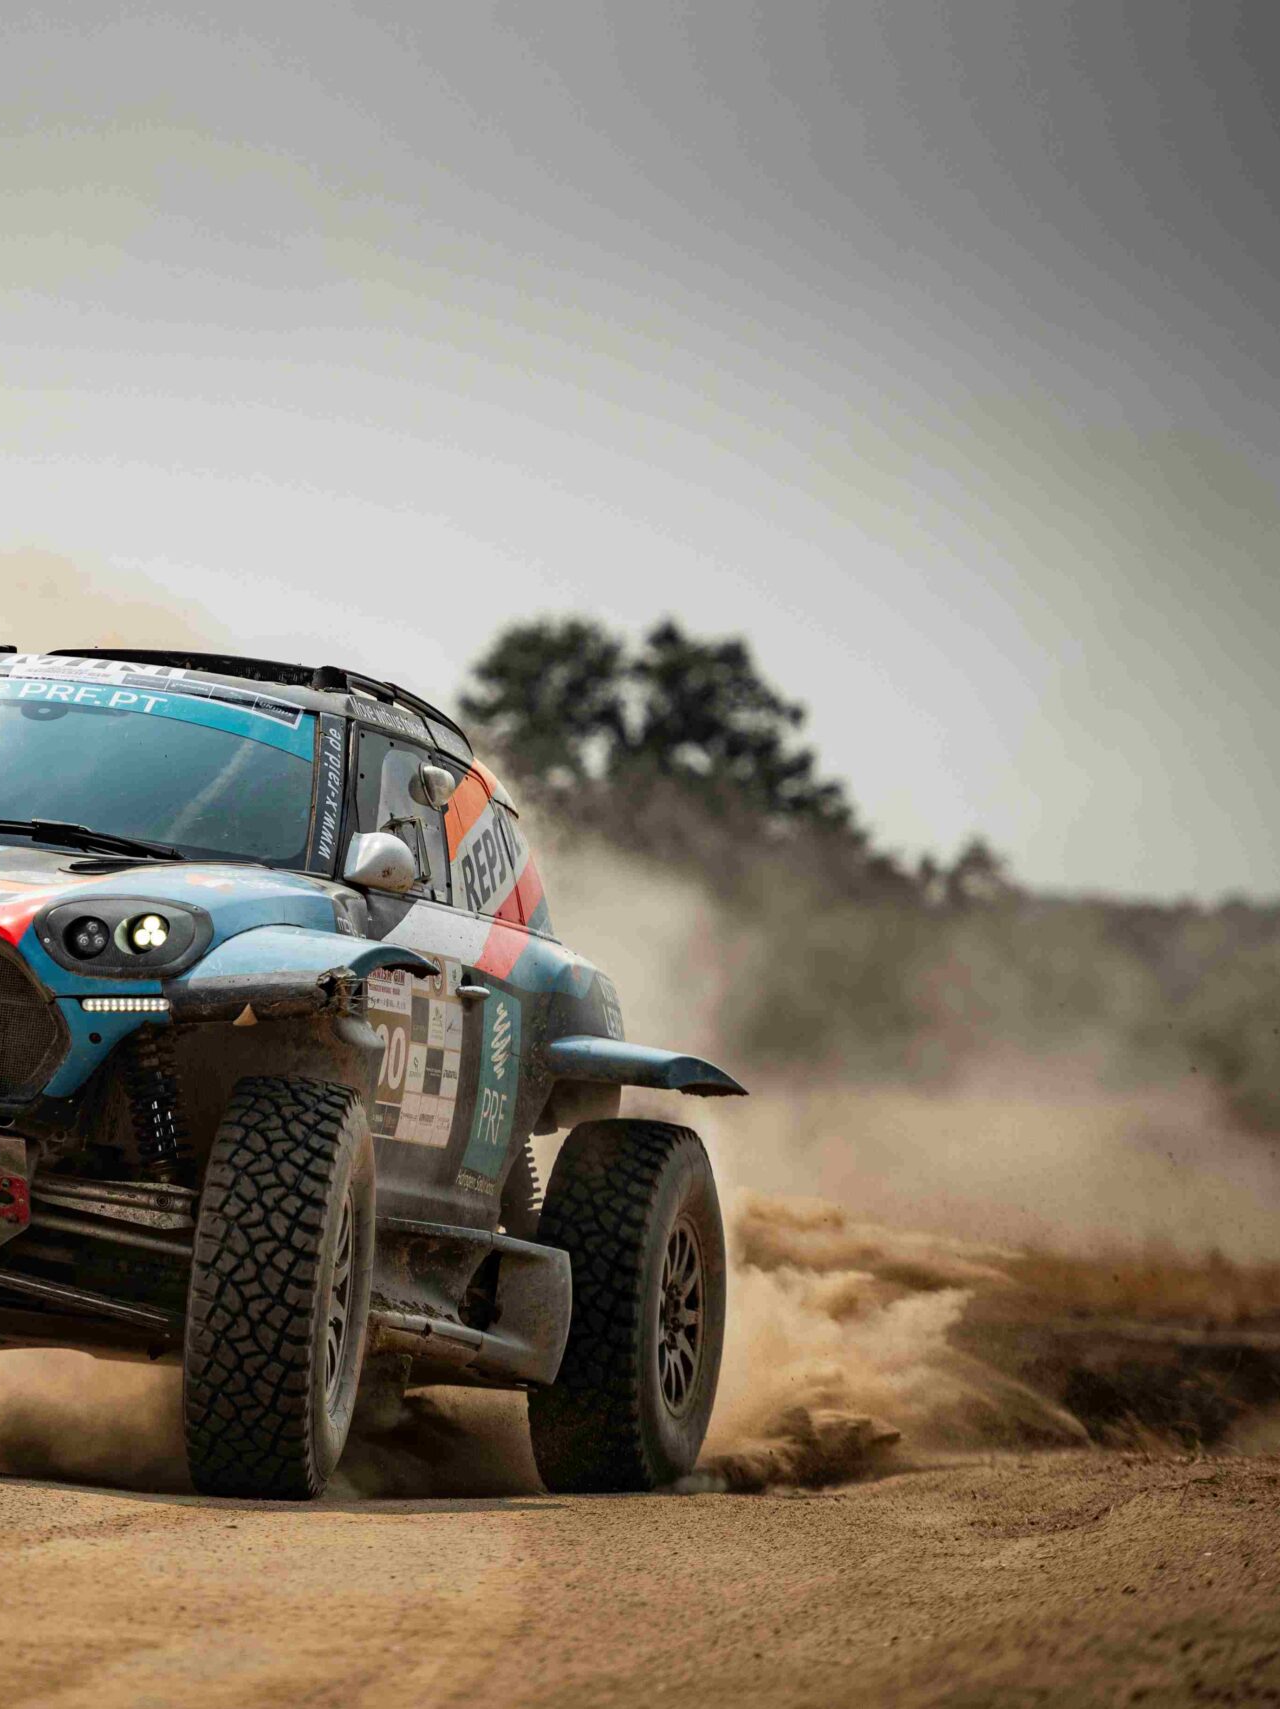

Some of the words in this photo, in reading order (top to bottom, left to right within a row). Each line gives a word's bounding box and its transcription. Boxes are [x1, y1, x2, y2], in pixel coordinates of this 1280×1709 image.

[19, 682, 169, 713] PRF.PT
[318, 727, 342, 860] www.x-raid.de
[477, 1087, 508, 1145] PRF
